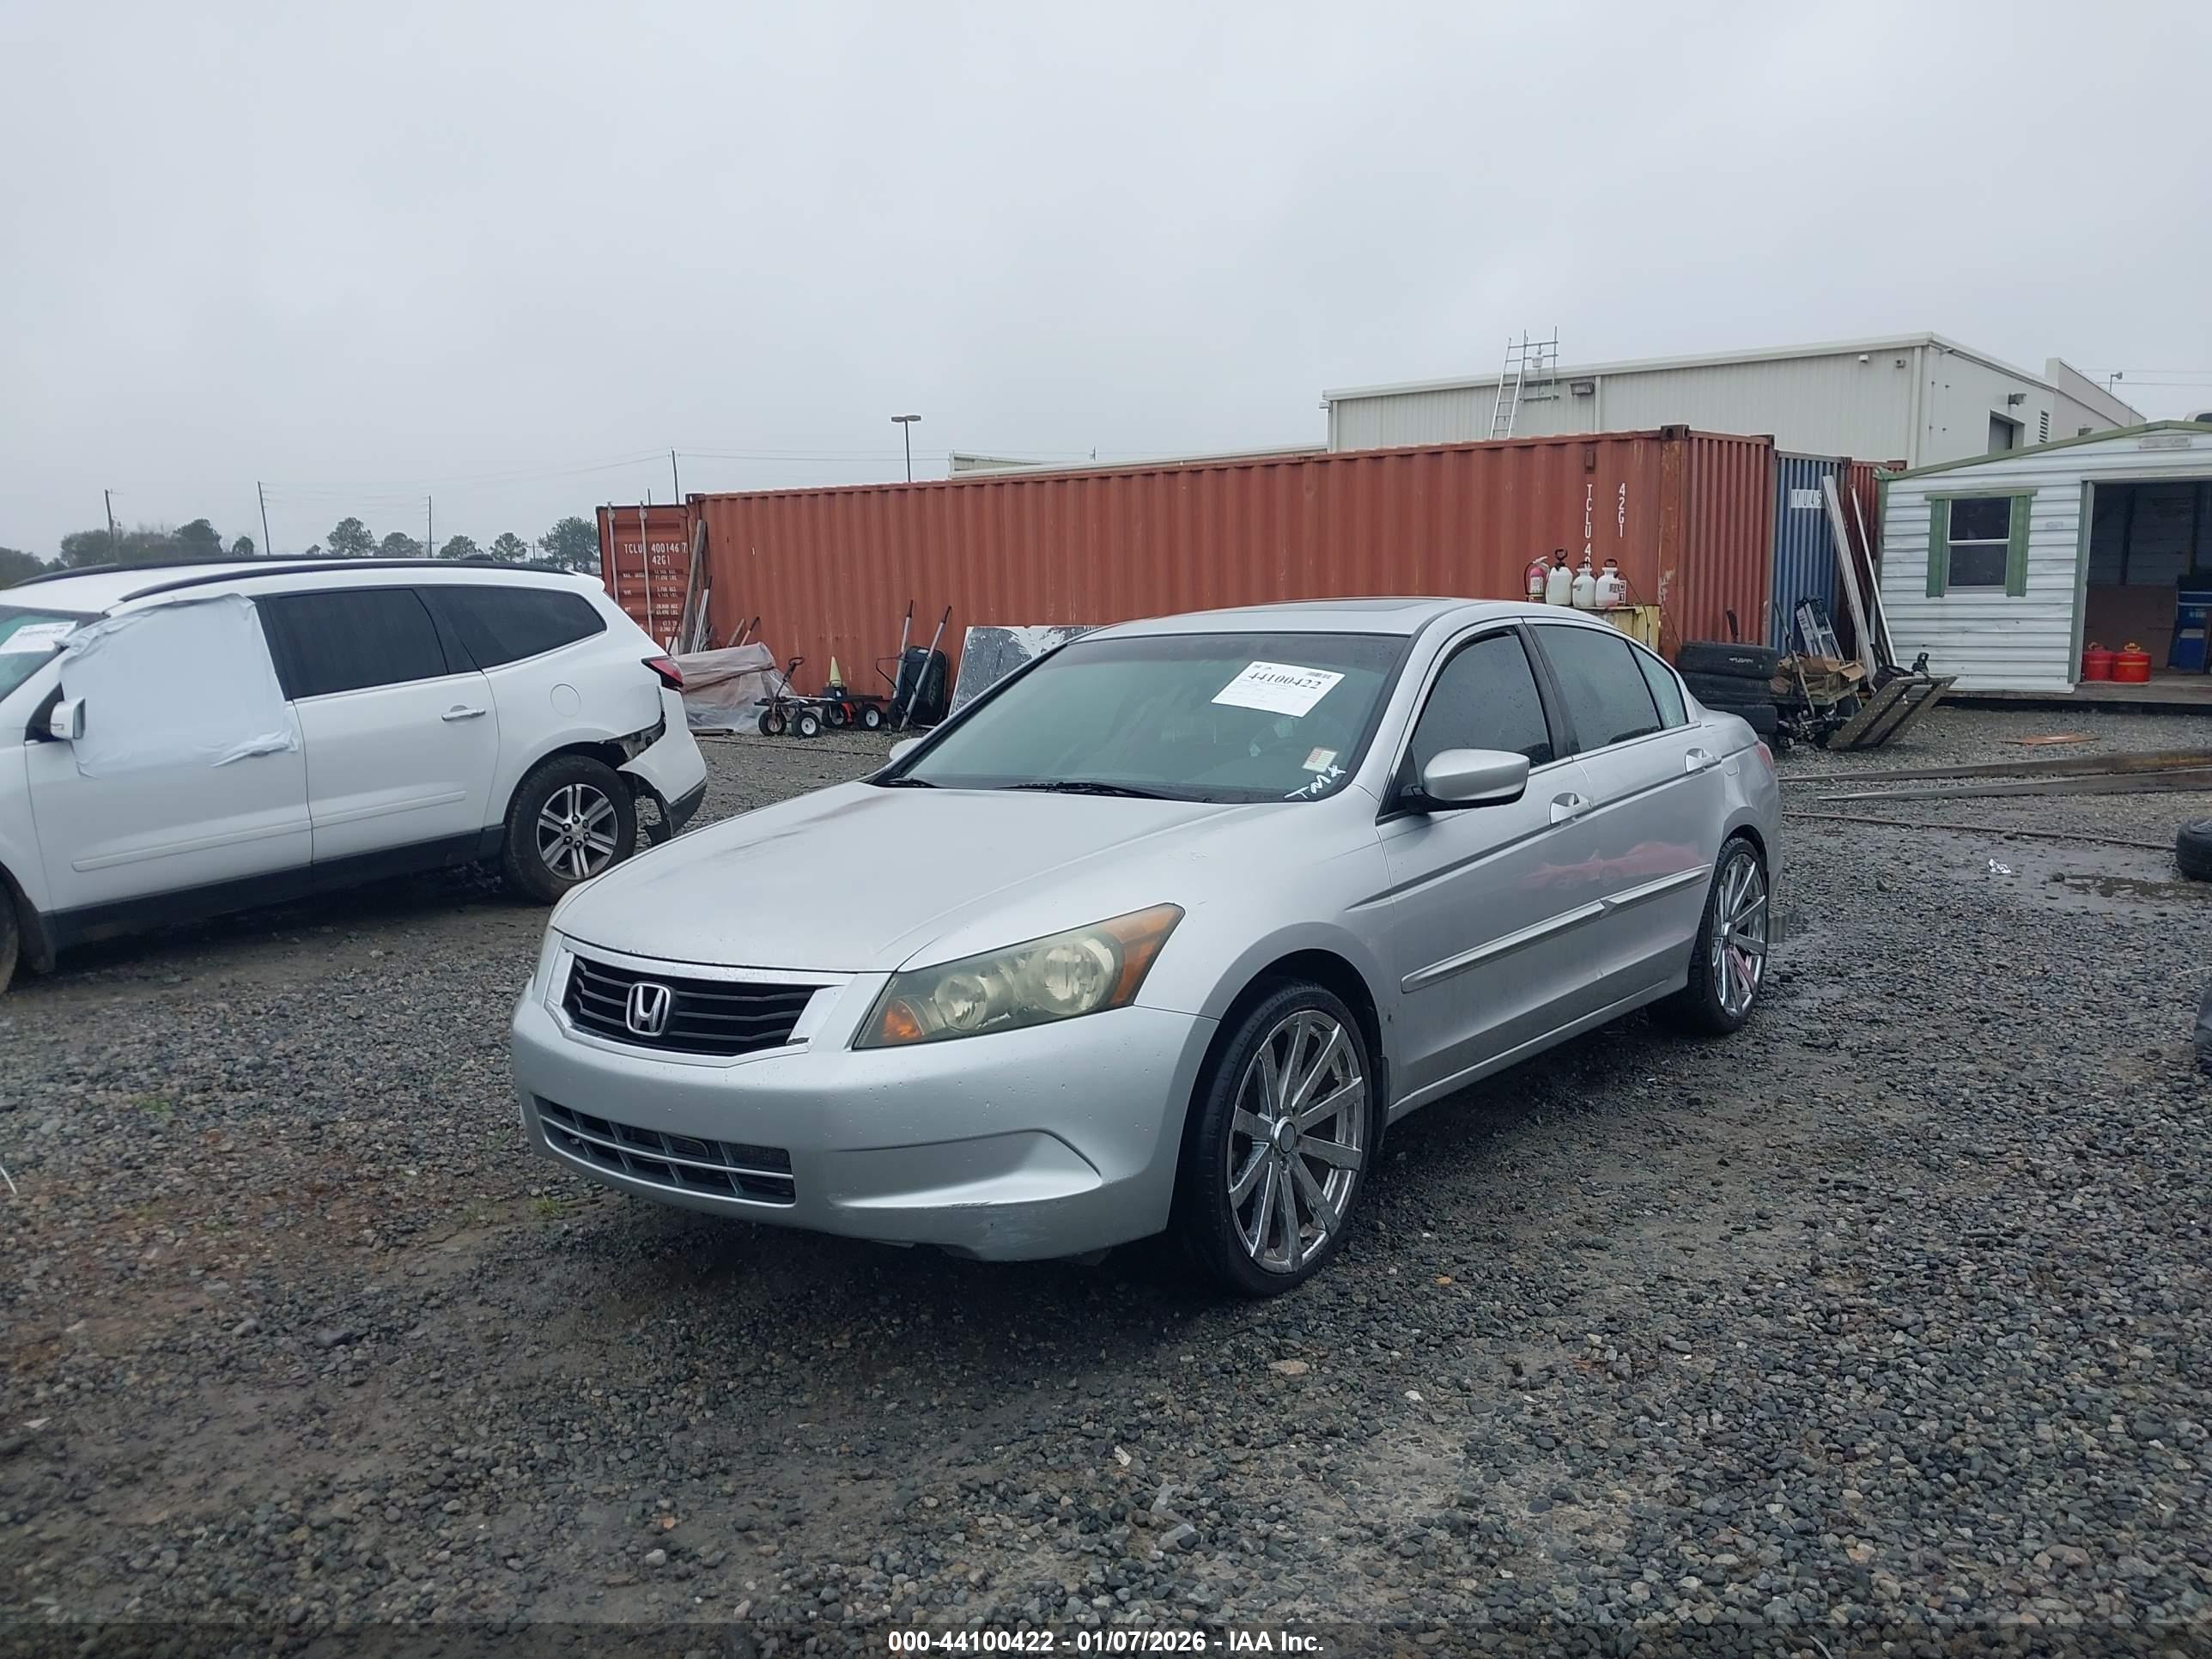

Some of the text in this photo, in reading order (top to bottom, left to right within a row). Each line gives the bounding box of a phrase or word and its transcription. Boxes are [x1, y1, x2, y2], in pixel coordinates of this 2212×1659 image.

[1584, 483, 1593, 538] TCLU
[623, 543, 642, 554] TCLU
[651, 542, 679, 554] 400146
[652, 555, 670, 565] 42G1
[1248, 672, 1322, 690] 44100422
